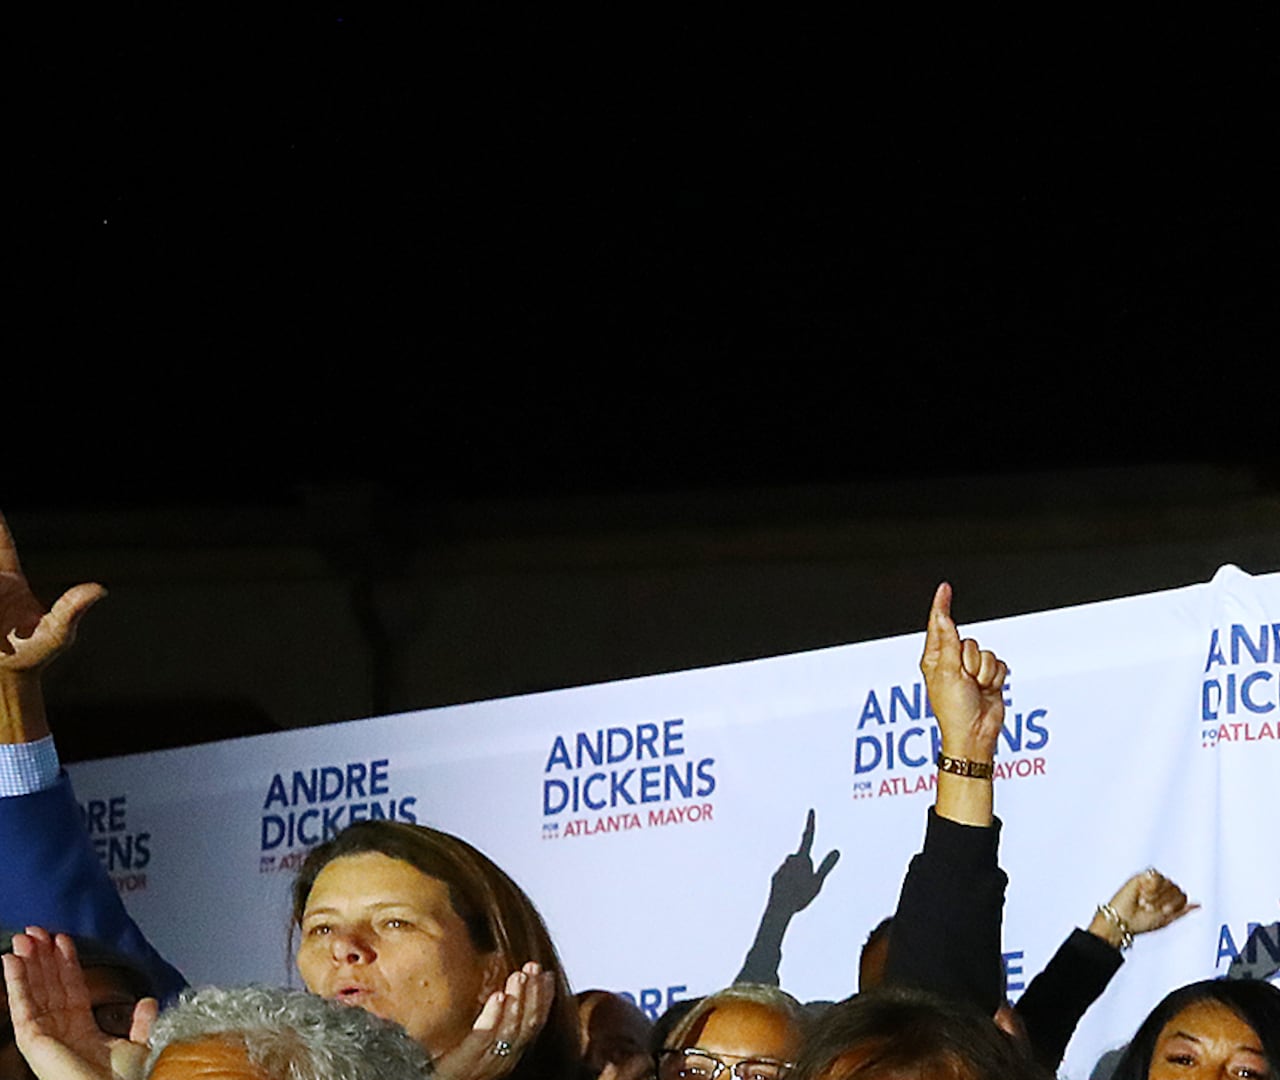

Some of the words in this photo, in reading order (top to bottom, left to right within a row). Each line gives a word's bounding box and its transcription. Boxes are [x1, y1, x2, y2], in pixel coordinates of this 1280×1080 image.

[545, 718, 685, 773] ANDRE
[854, 709, 1049, 775] DICNS
[1202, 729, 1217, 739] FO
[264, 759, 389, 810] ANDRE
[543, 758, 716, 816] DICKENS
[853, 782, 872, 791] FOR
[992, 757, 1046, 780] AYOR
[563, 813, 642, 837] ATLANTA
[648, 803, 714, 828] MAYOR
